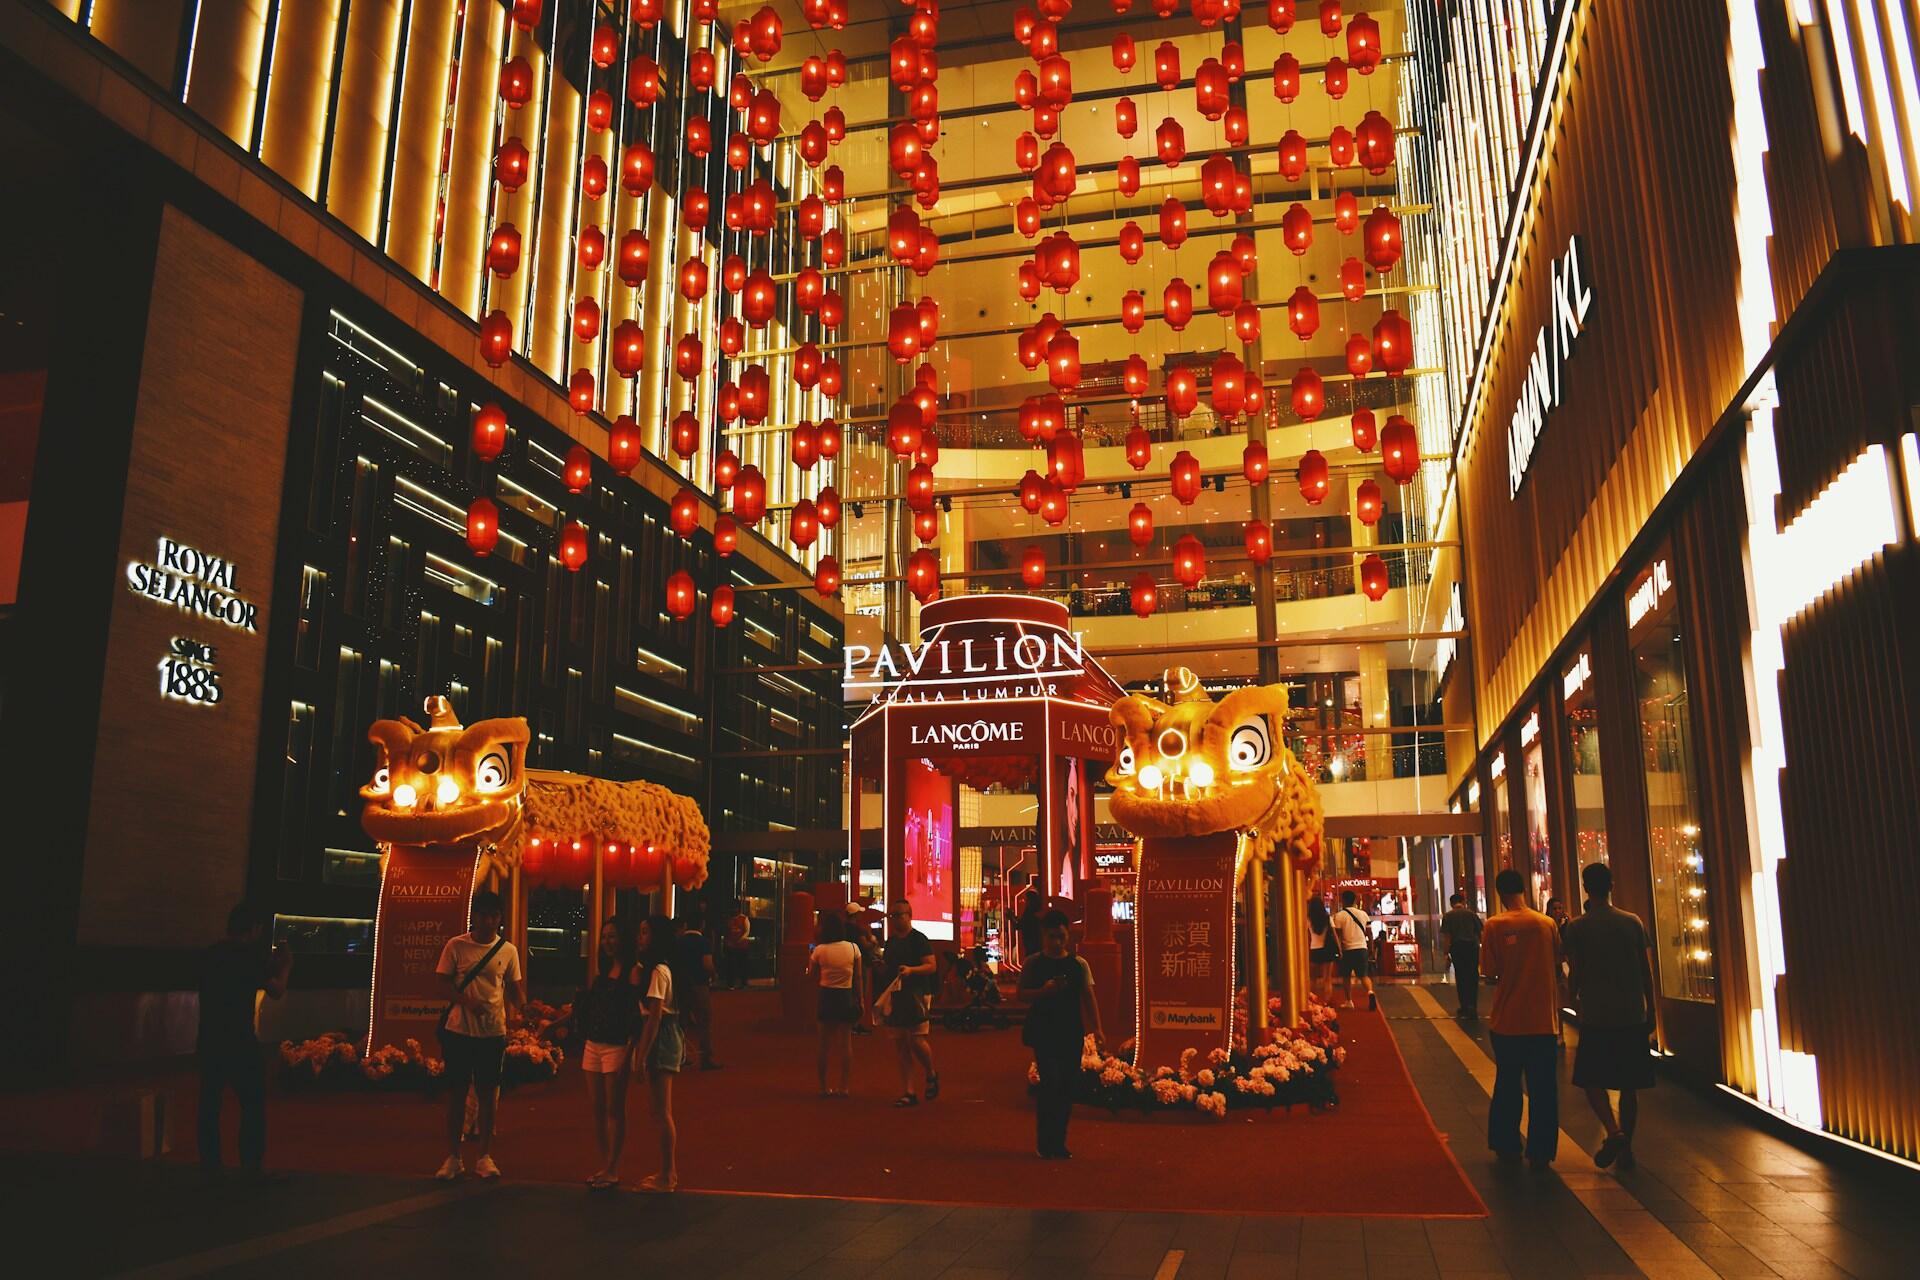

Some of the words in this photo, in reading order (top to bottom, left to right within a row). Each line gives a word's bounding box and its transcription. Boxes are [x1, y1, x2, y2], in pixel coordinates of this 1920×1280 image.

[161, 538, 240, 593] ROYAL
[130, 562, 258, 631] SELANGOR
[842, 631, 1085, 680] PAVILION
[162, 658, 223, 704] 1885
[871, 690, 945, 704] KUALA
[962, 684, 1059, 701] LUMPUR
[911, 720, 1024, 744] LANCÔME
[1061, 720, 1117, 747] LANCÔ
[1091, 746, 1109, 754] PARIS
[391, 885, 462, 895] PAVILION
[1148, 878, 1223, 890] PAVILION
[1167, 1013, 1217, 1025] Maybank
